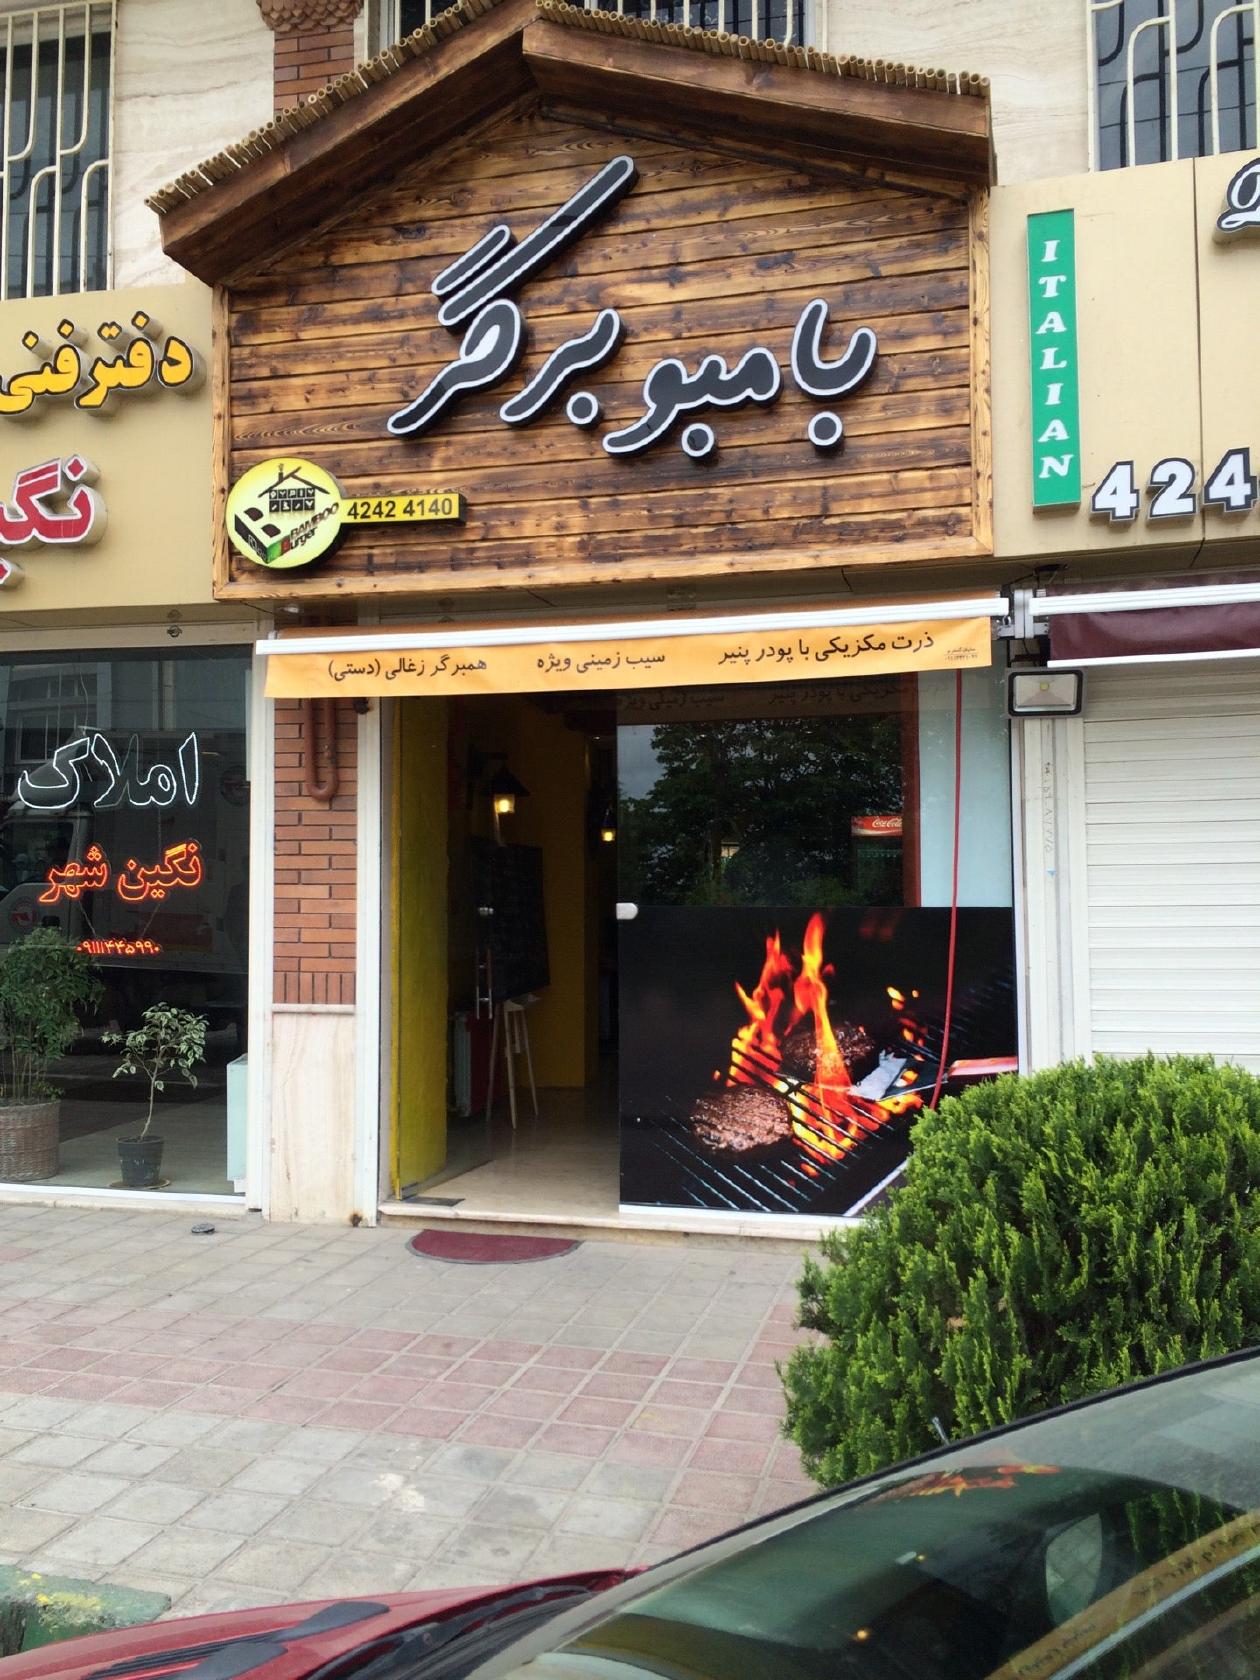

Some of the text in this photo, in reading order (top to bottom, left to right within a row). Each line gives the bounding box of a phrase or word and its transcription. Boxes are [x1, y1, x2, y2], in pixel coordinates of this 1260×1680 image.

[386, 154, 878, 458] بامبو برگر
[74, 310, 194, 410] دفتر
[1034, 239, 1075, 479] ITALIAN
[347, 497, 453, 520] 4242 4140
[1090, 446, 1260, 523] 424
[327, 657, 382, 682] (دستی)
[384, 656, 425, 681] زغالی
[536, 651, 665, 673] سیب زمینی ویژه
[716, 631, 935, 665] ذرت مکزیکی با پودر پنیر
[17, 732, 199, 810] املاک
[38, 842, 202, 903] نگین شهر
